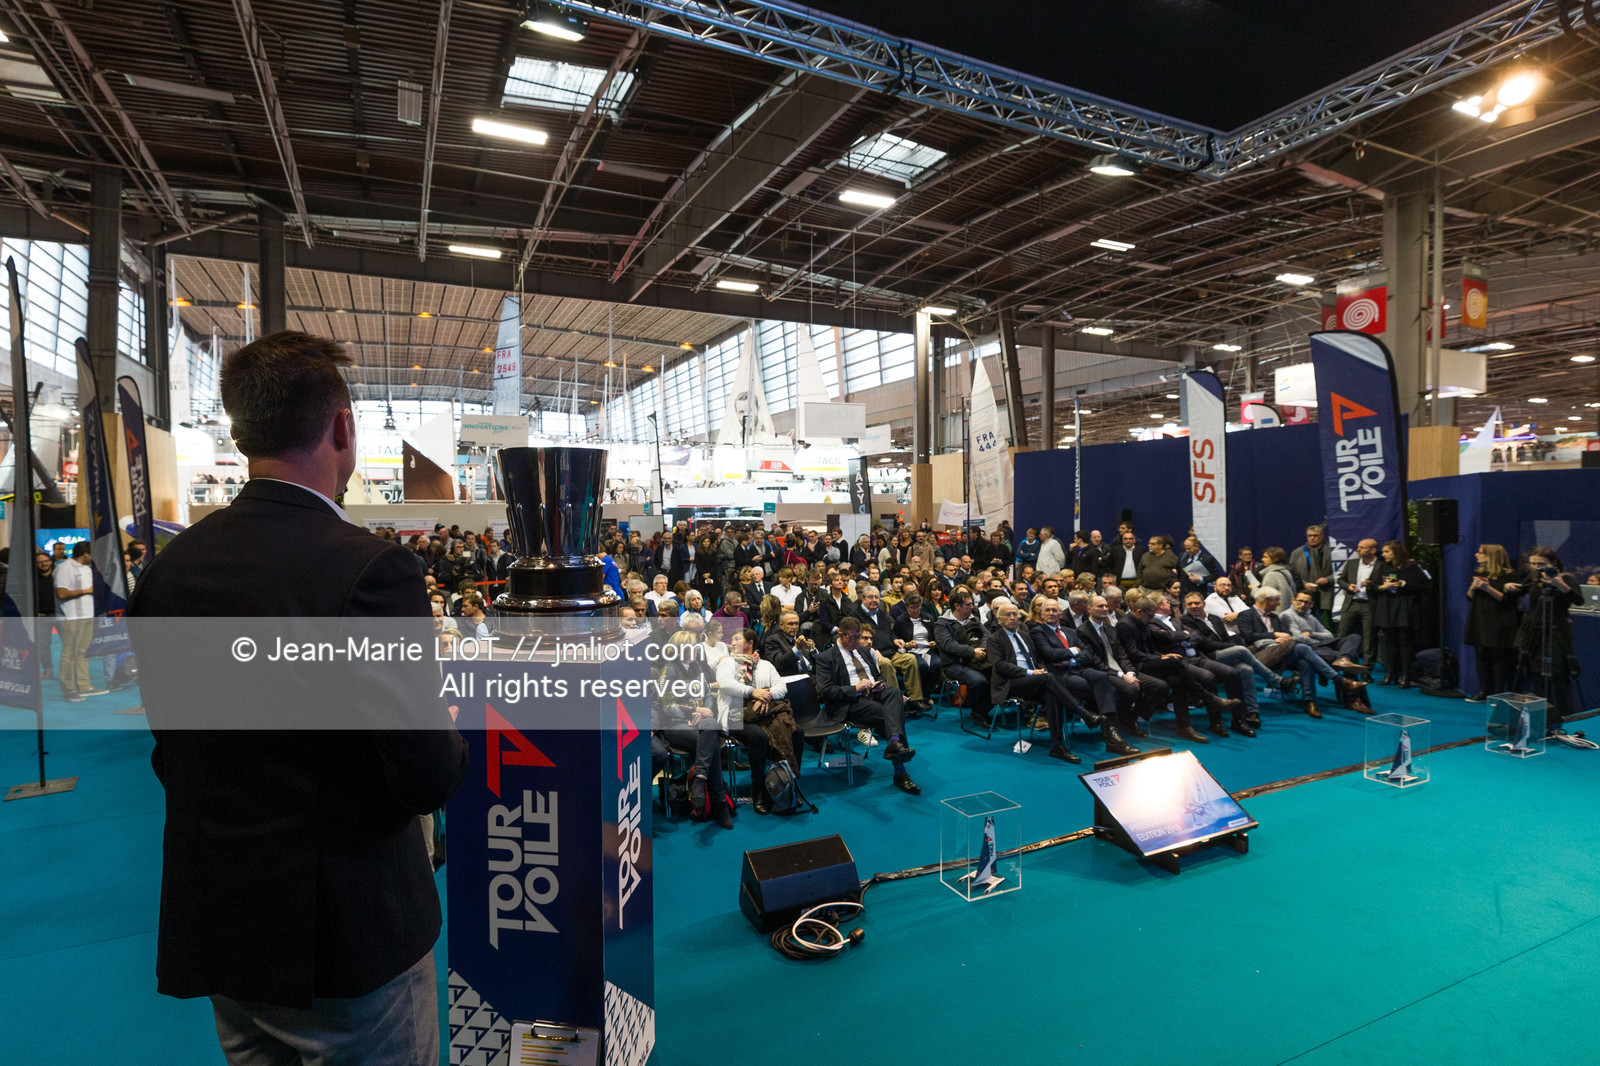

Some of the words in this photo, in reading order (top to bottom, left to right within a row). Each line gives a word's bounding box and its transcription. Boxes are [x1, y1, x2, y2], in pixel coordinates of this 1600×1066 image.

[497, 350, 511, 359] FRA
[976, 431, 995, 444] FRA
[1192, 438, 1216, 504] SFS
[1335, 437, 1362, 512] TOUR
[1358, 426, 1387, 500] VOILE
[523, 789, 560, 933] VOILE
[617, 782, 631, 930] TOUR
[629, 756, 642, 895] VOILE
[487, 804, 524, 950] TOUR
